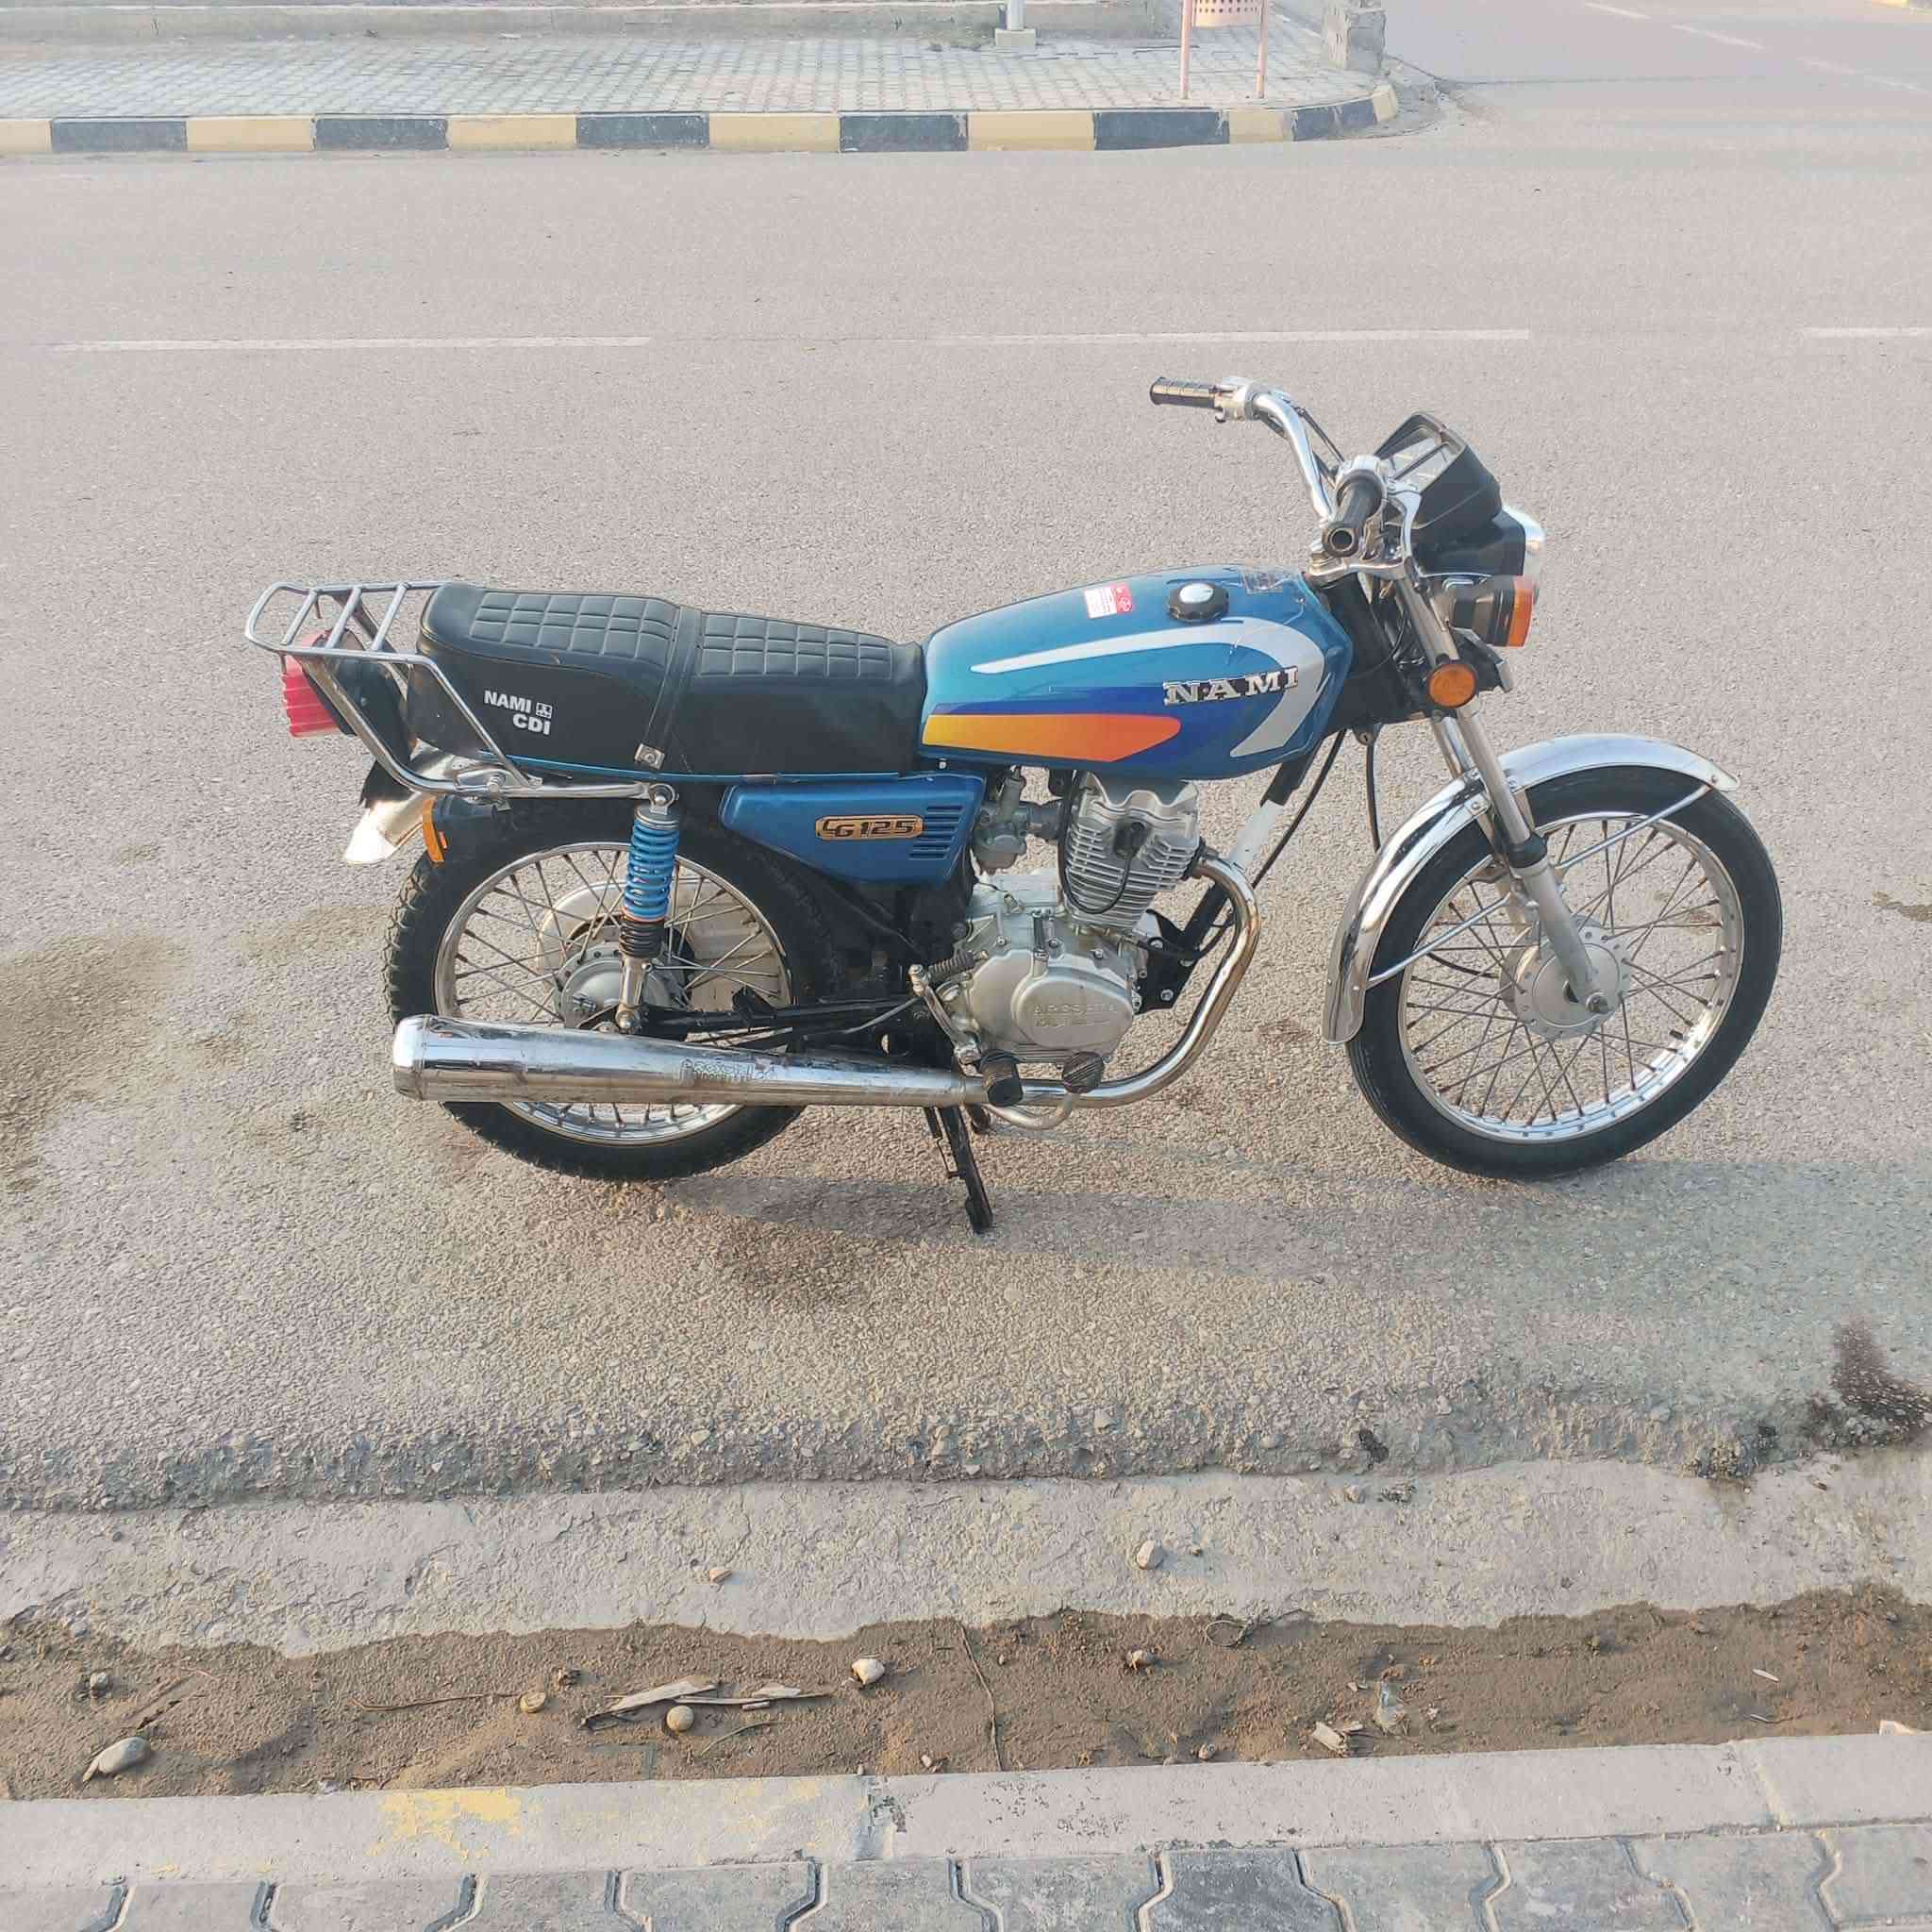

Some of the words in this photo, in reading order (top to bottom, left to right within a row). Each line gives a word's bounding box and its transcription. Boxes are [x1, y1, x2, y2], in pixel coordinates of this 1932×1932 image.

[1164, 666, 1298, 706] NAMI
[484, 690, 532, 713] NAMI
[512, 713, 551, 736] CDI
